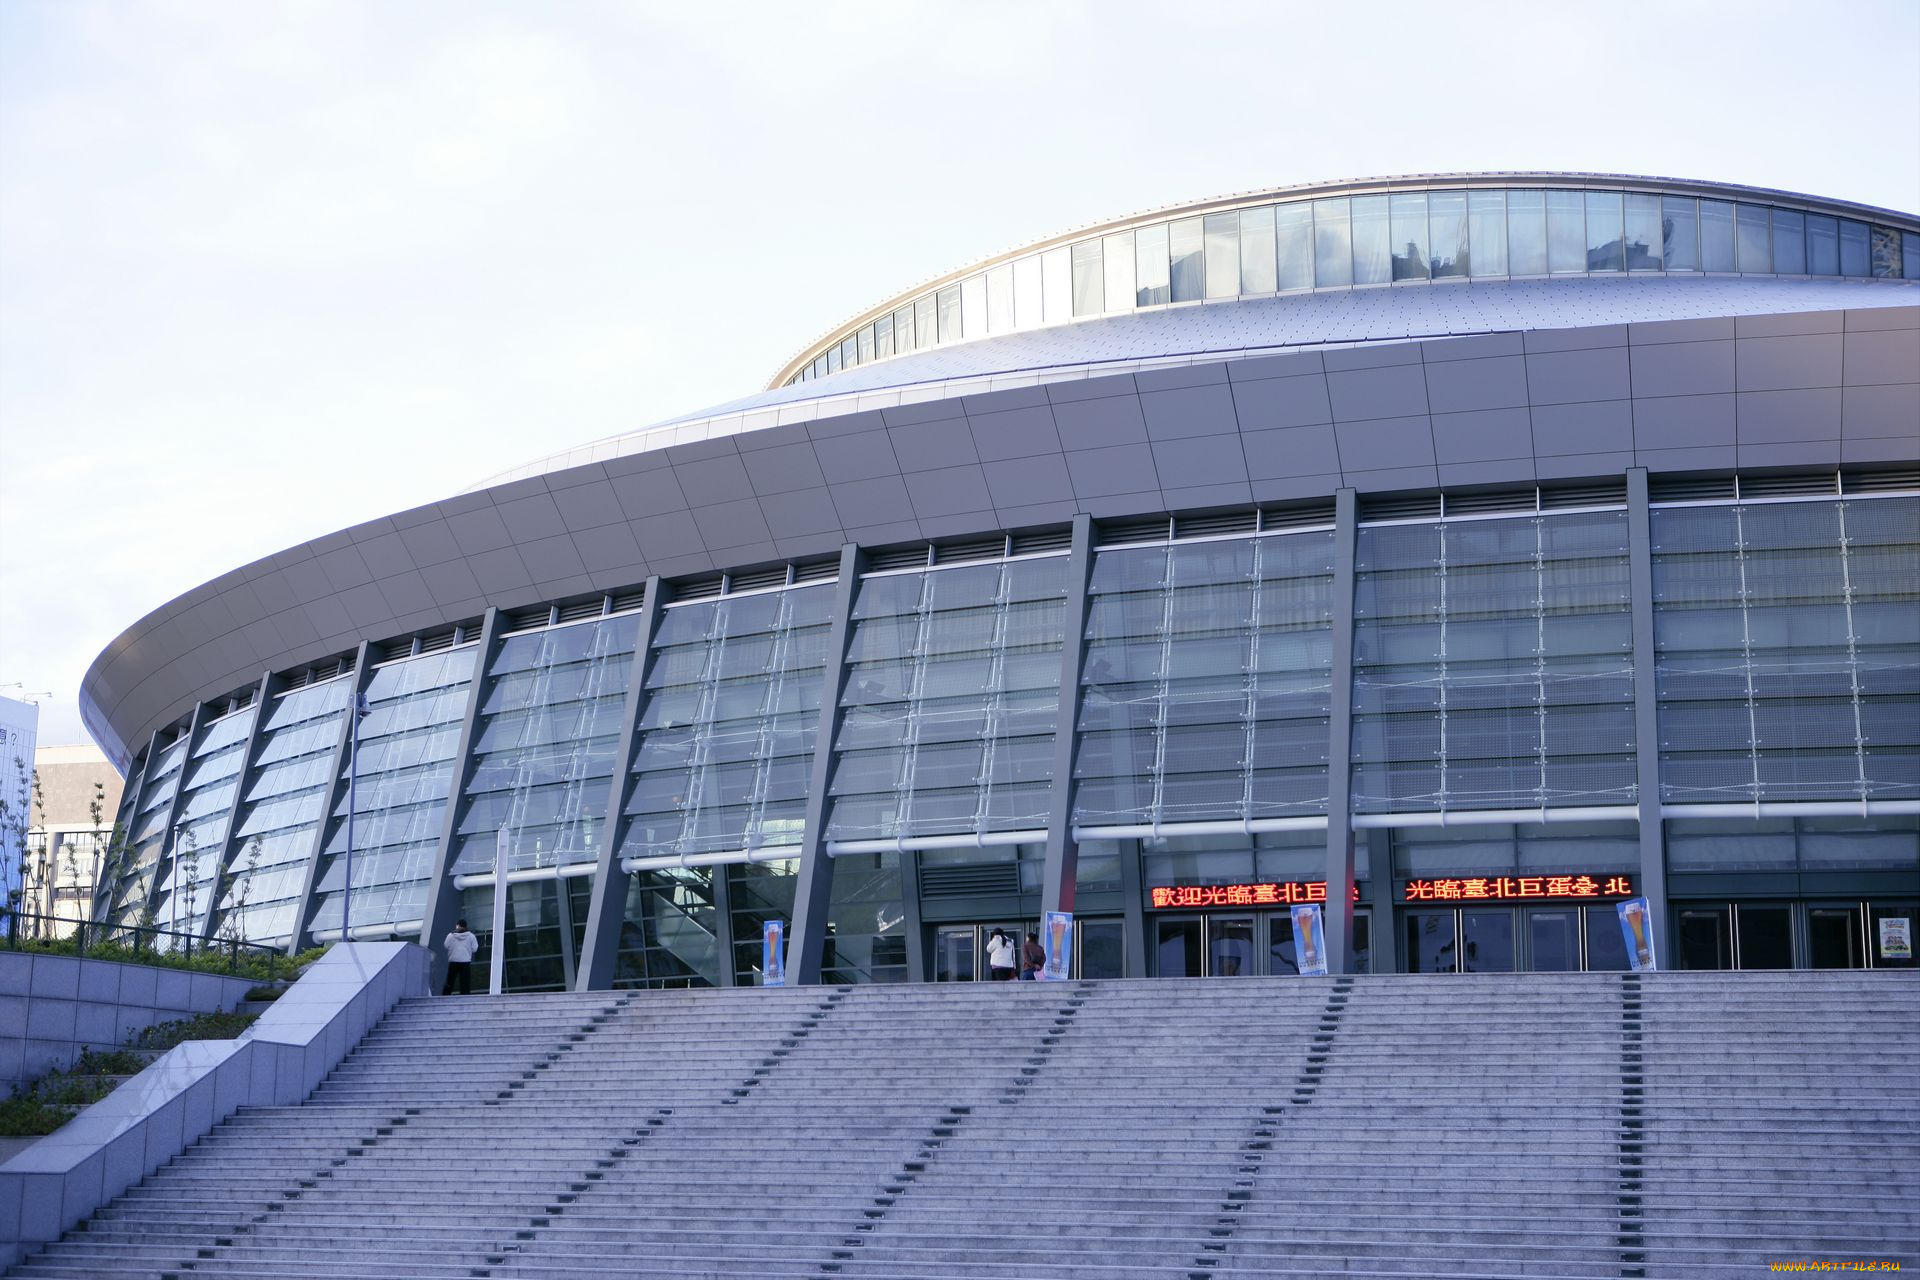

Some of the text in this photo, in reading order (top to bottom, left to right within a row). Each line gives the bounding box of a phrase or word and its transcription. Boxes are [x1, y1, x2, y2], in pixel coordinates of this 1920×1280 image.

[1152, 881, 1359, 908] 歡迎光臨臺北巨
